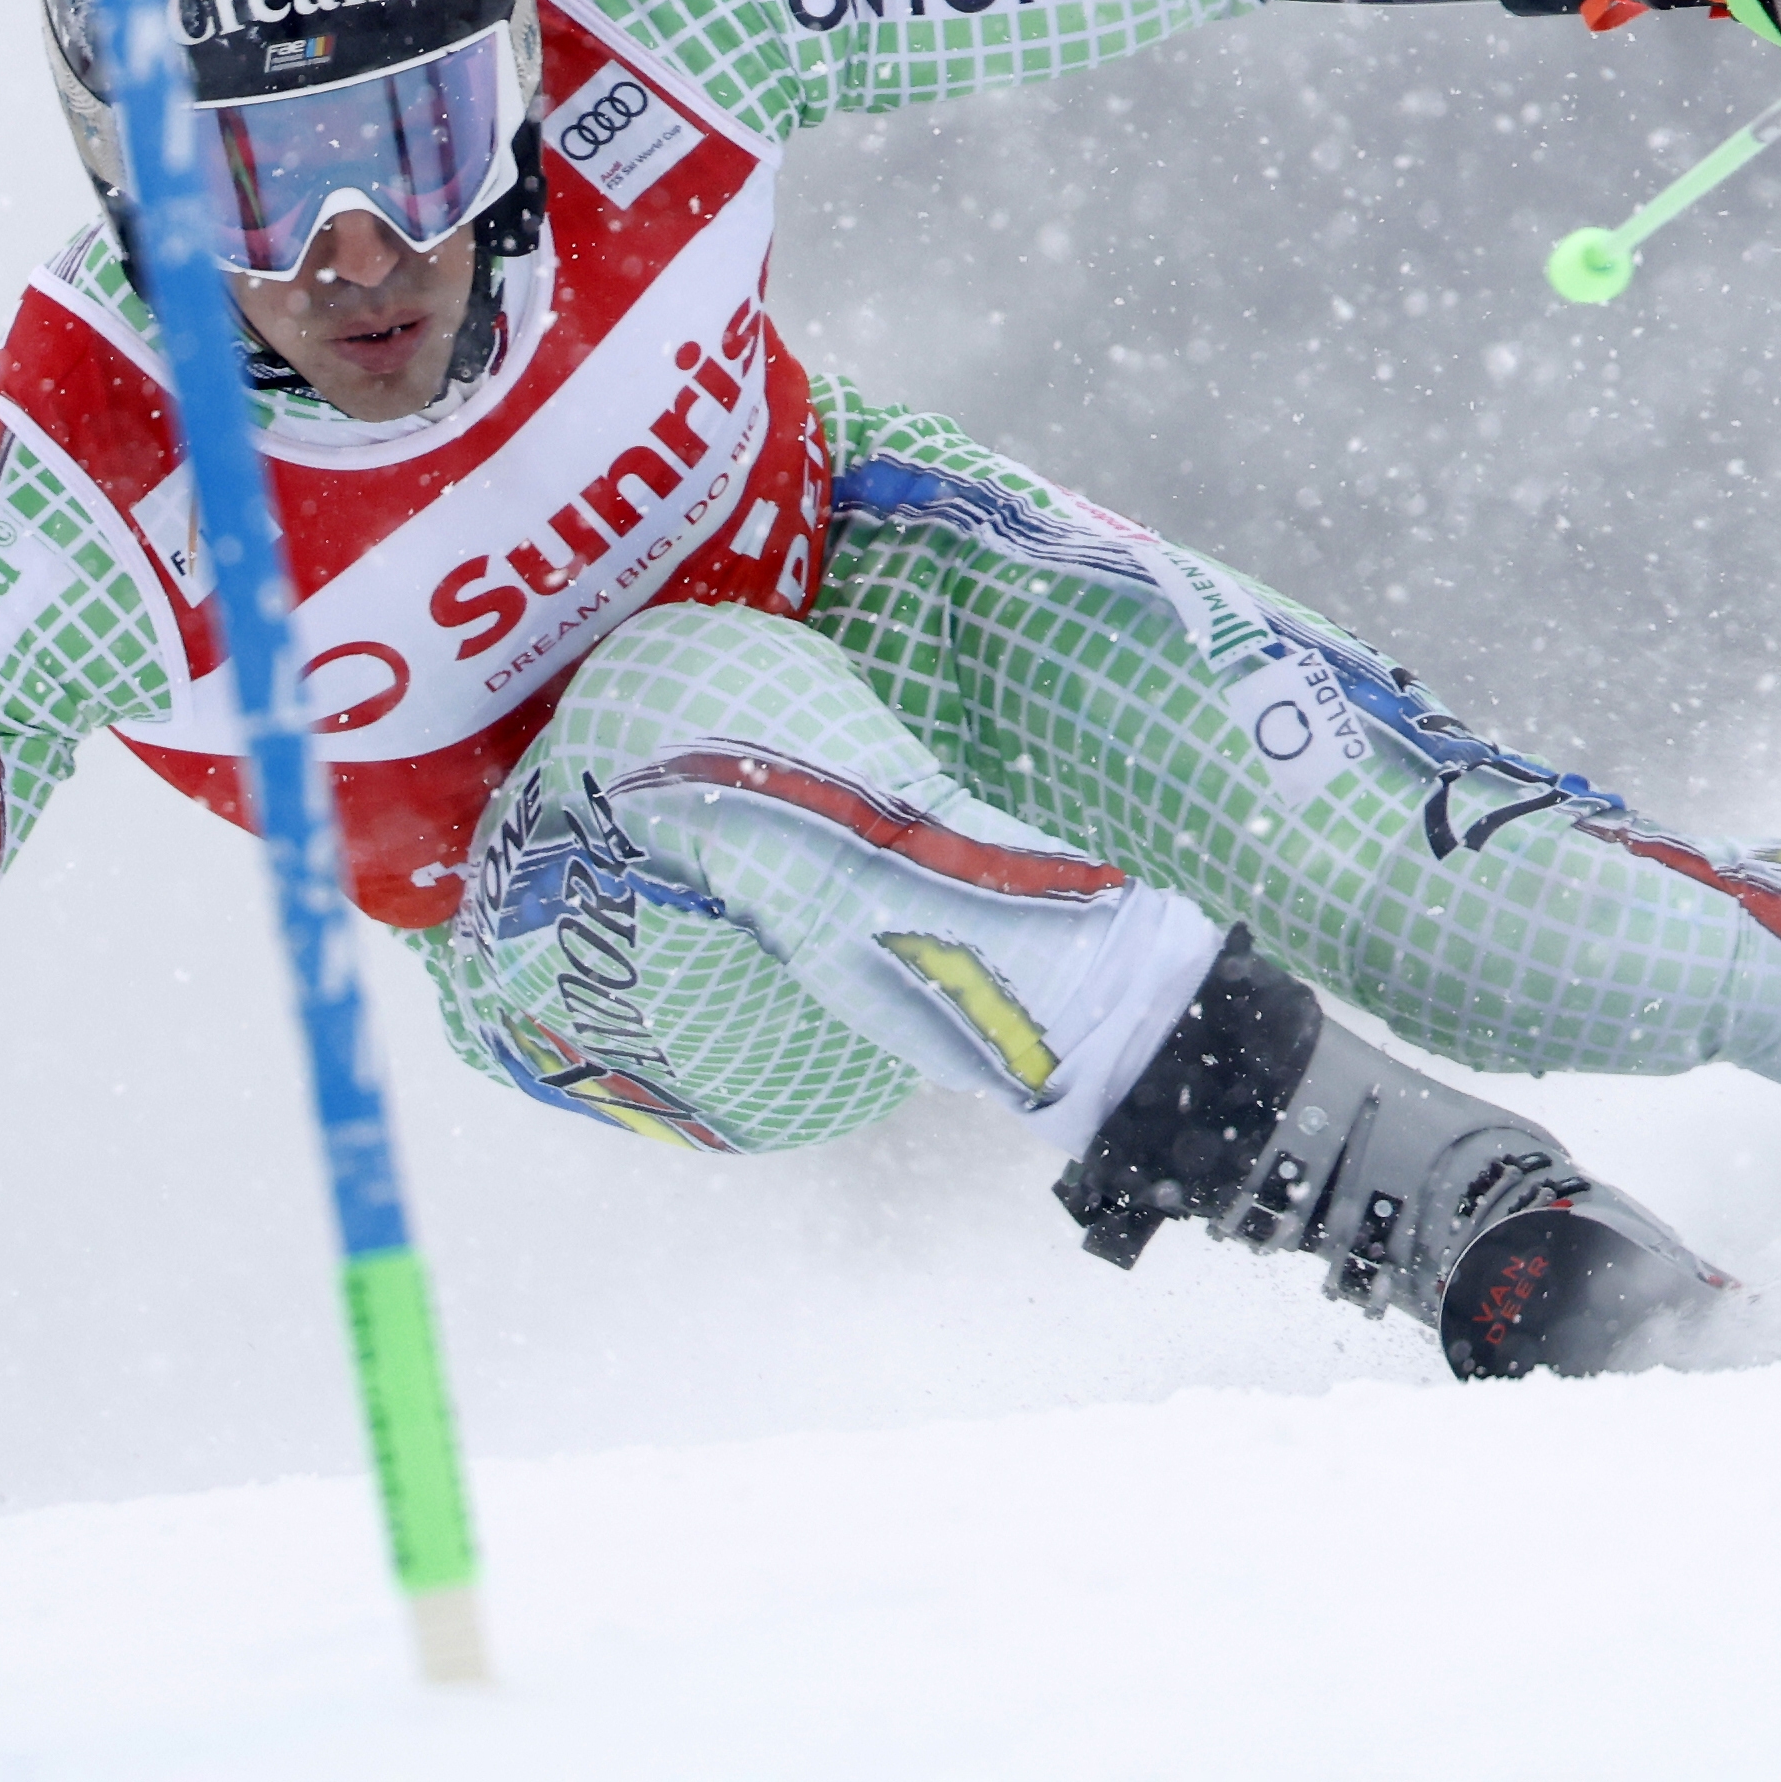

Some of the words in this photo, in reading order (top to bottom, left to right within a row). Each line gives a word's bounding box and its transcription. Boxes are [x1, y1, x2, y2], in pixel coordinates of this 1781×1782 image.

[429, 296, 765, 661] Sunris
[484, 588, 611, 694] DREAM
[683, 472, 730, 526] DO
[1298, 650, 1367, 761] CALDEA
[1472, 1255, 1526, 1322] VAN
[1484, 1256, 1550, 1345] DEER
